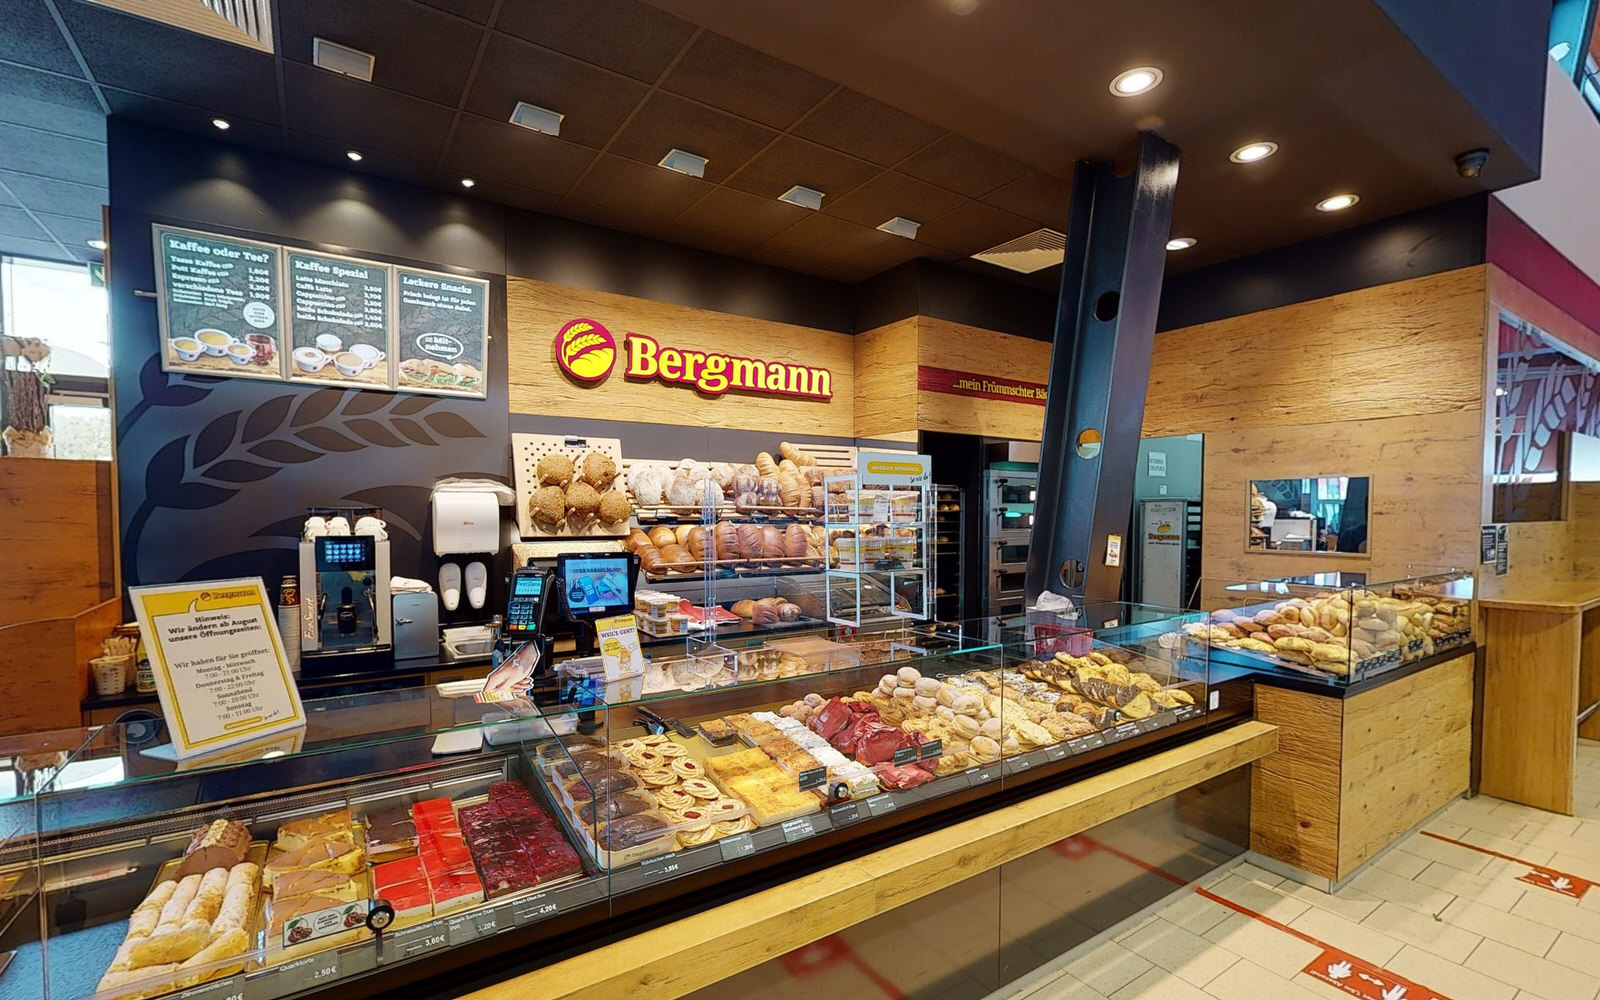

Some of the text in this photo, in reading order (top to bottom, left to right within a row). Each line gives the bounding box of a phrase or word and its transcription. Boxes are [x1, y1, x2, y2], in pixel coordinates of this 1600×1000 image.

[169, 239, 270, 263] Kaffee oder Tee?
[170, 255, 194, 264] Tasse
[195, 258, 221, 268] Kaffee
[190, 267, 216, 276] Kaffee
[294, 260, 368, 279] Kaffee Spezial
[172, 272, 207, 283] Espresso
[296, 275, 350, 288] Latte Macchiato
[172, 282, 225, 294] verschiedene
[315, 285, 333, 293] Latte
[402, 276, 472, 294] Leckere Snacks
[296, 290, 336, 300] Cappuccino
[402, 290, 422, 298] Frisch
[423, 292, 440, 301] belegt
[296, 298, 336, 308] Cappuccino
[402, 298, 436, 307] Geschmack
[317, 308, 354, 318] Schokolade
[317, 316, 354, 325] Schokolade
[425, 344, 458, 352] nehmen
[626, 333, 832, 397] Bergmann
[982, 380, 1034, 398] Frömmschter
[213, 590, 256, 600] Bergmann
[194, 614, 230, 624] Hinweis:
[168, 626, 186, 634] Wir
[188, 622, 218, 632] ändern
[231, 618, 258, 627] August
[168, 624, 262, 642] unsere Öffnungszeiten:
[174, 661, 188, 670] Wir
[191, 657, 214, 667] haben
[228, 652, 240, 660] Sie
[240, 648, 270, 660] geöffnet:
[196, 664, 222, 674] Montag
[226, 658, 256, 668] Mittwoch
[195, 677, 234, 689] Donnerstag
[242, 671, 264, 681] Freitag
[205, 672, 219, 680] 7:00
[216, 687, 253, 700] Sonnabend
[213, 699, 227, 707] 7:00
[226, 702, 252, 712] Sonntag
[252, 705, 263, 713] Uhr
[540, 904, 558, 914] 4,20€
[449, 917, 465, 925] Quark
[394, 923, 433, 938] Schneewittchen
[425, 934, 445, 947] 3,60€
[280, 958, 314, 971] Quarktorte
[314, 966, 337, 980] 2,50€
[180, 979, 234, 998] Zitronenröllchen
